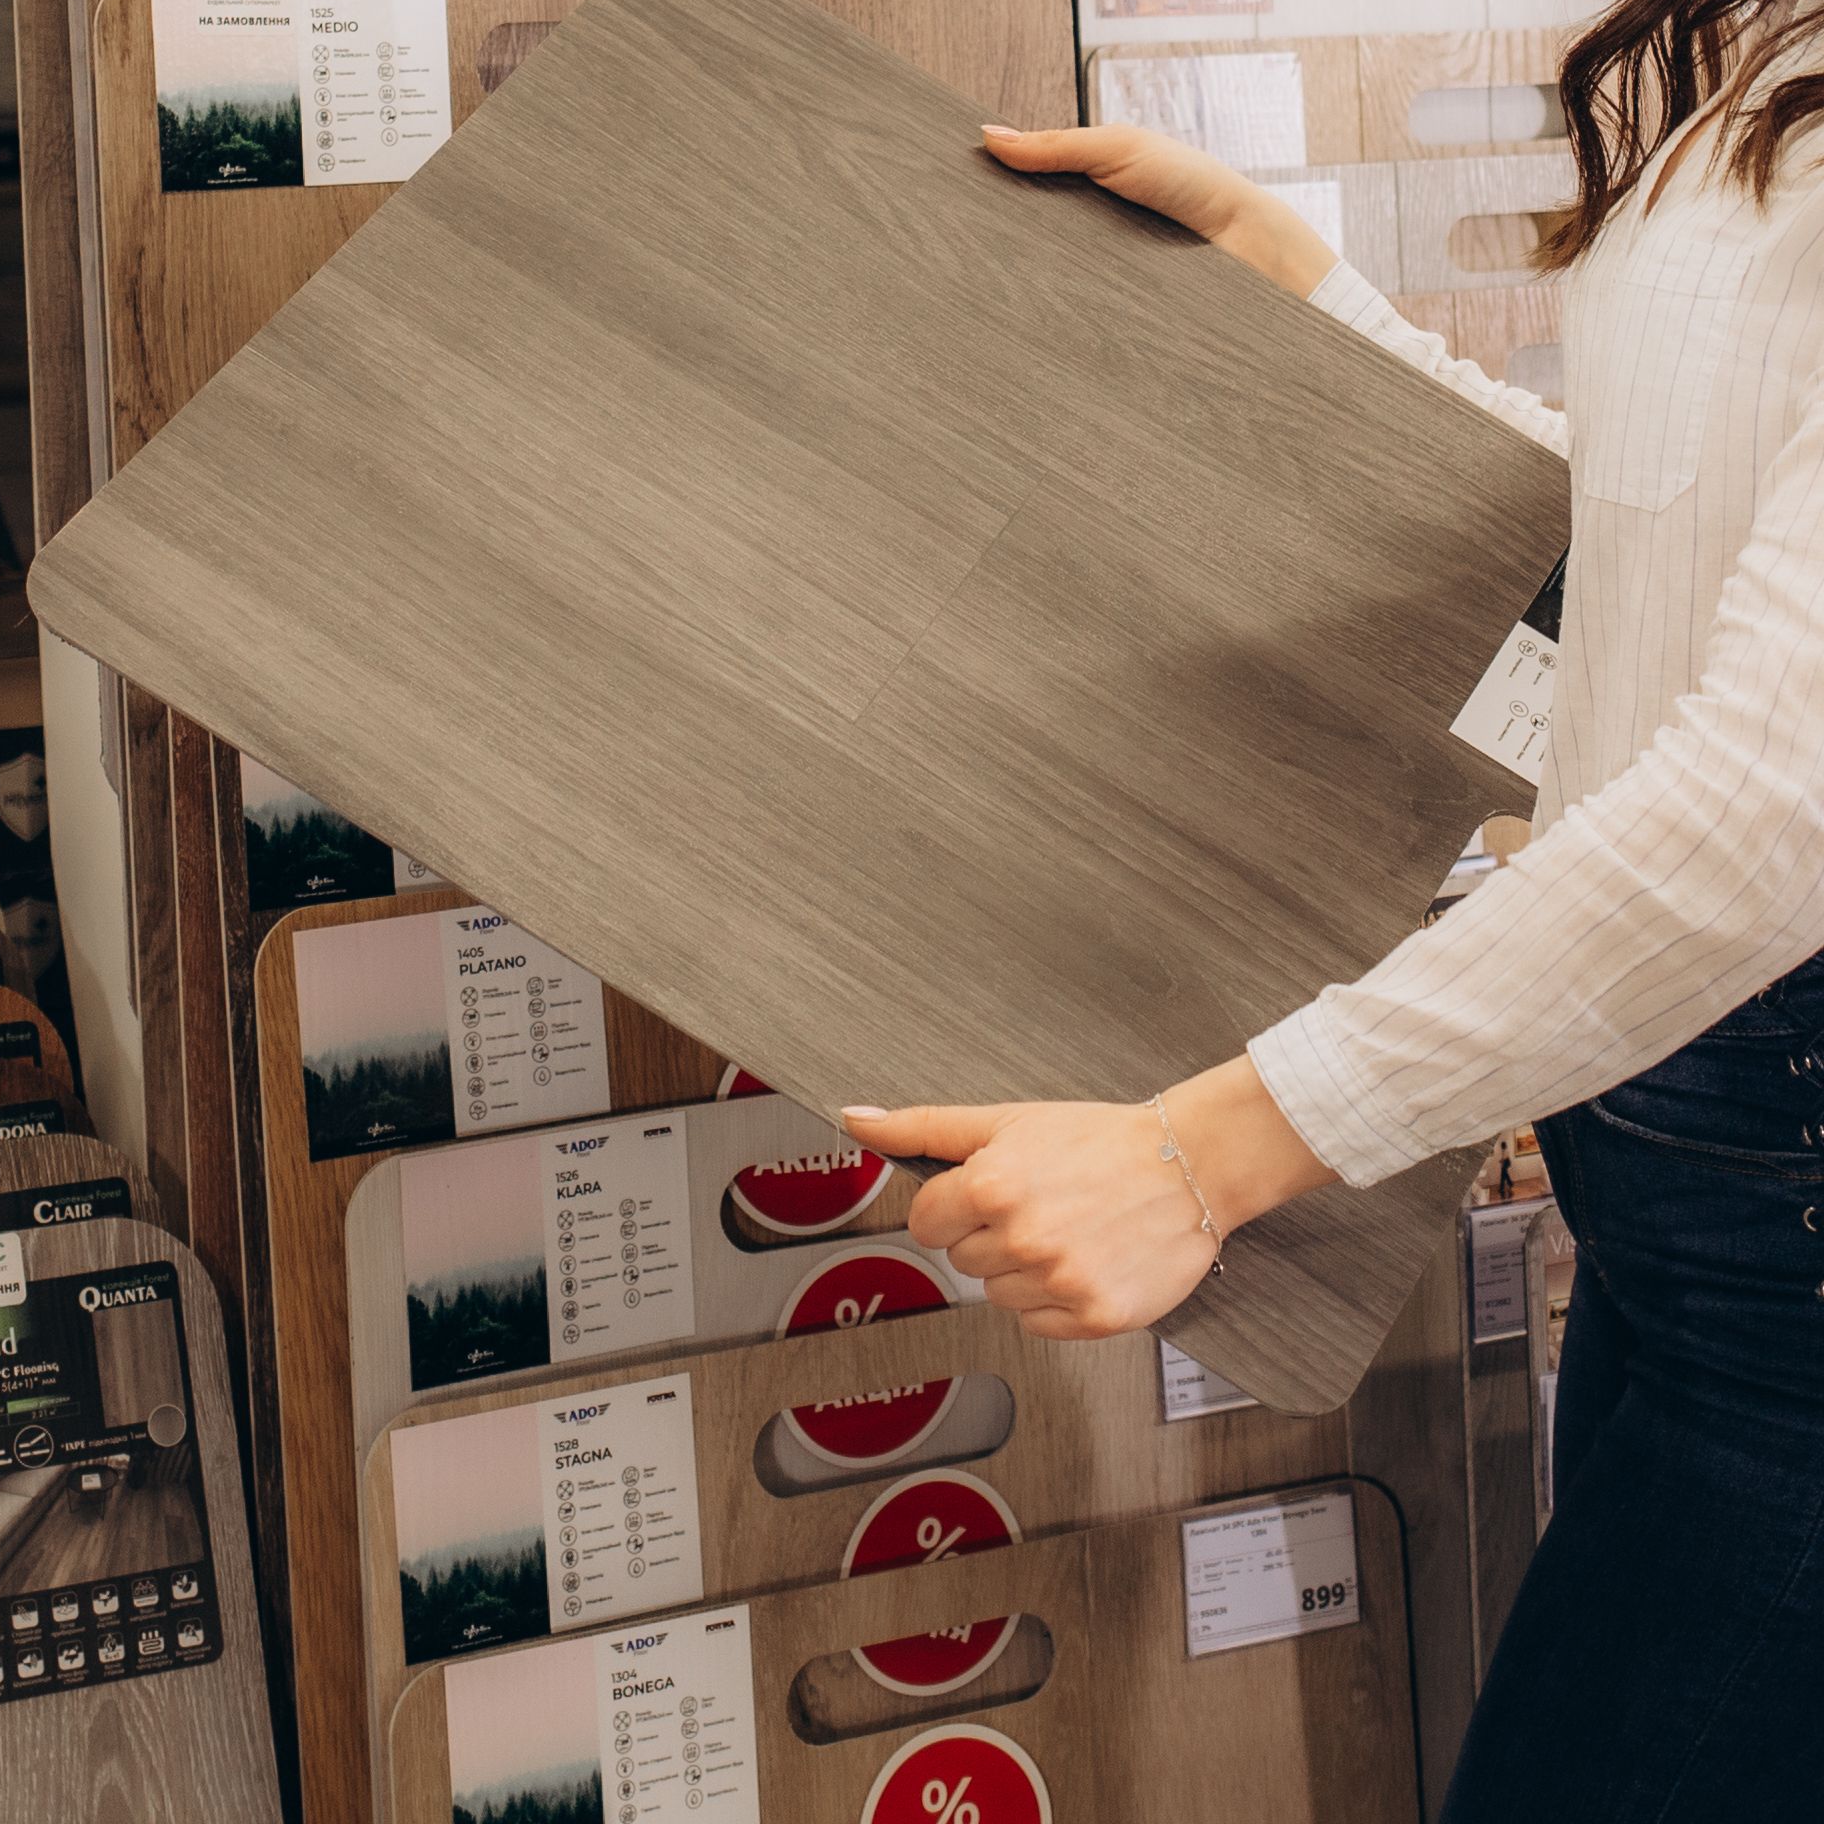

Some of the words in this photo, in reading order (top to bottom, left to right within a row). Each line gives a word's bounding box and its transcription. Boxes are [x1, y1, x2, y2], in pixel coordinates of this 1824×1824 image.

[310, 8, 334, 18] 1525
[199, 17, 213, 26] НА
[216, 17, 290, 26] ЗАМОВЛЕННЯ
[312, 22, 358, 33] MEDIO
[472, 917, 500, 930] ADO
[457, 947, 484, 959] 1405
[460, 955, 526, 975] PLATANO
[570, 1139, 596, 1153] ADO
[556, 1170, 579, 1183] 1526
[557, 1181, 602, 1199] KLARA
[34, 1200, 92, 1224] CLAIR
[79, 1286, 157, 1312] QUANTA
[569, 1407, 597, 1421] ADO
[554, 1439, 579, 1452] 1528
[556, 1448, 612, 1469] STAGNA
[1302, 1583, 1345, 1611] 899
[627, 1637, 655, 1652] ADO
[611, 1669, 637, 1683] 1304
[613, 1677, 674, 1700] BONEGA
[922, 1777, 980, 1824] %
